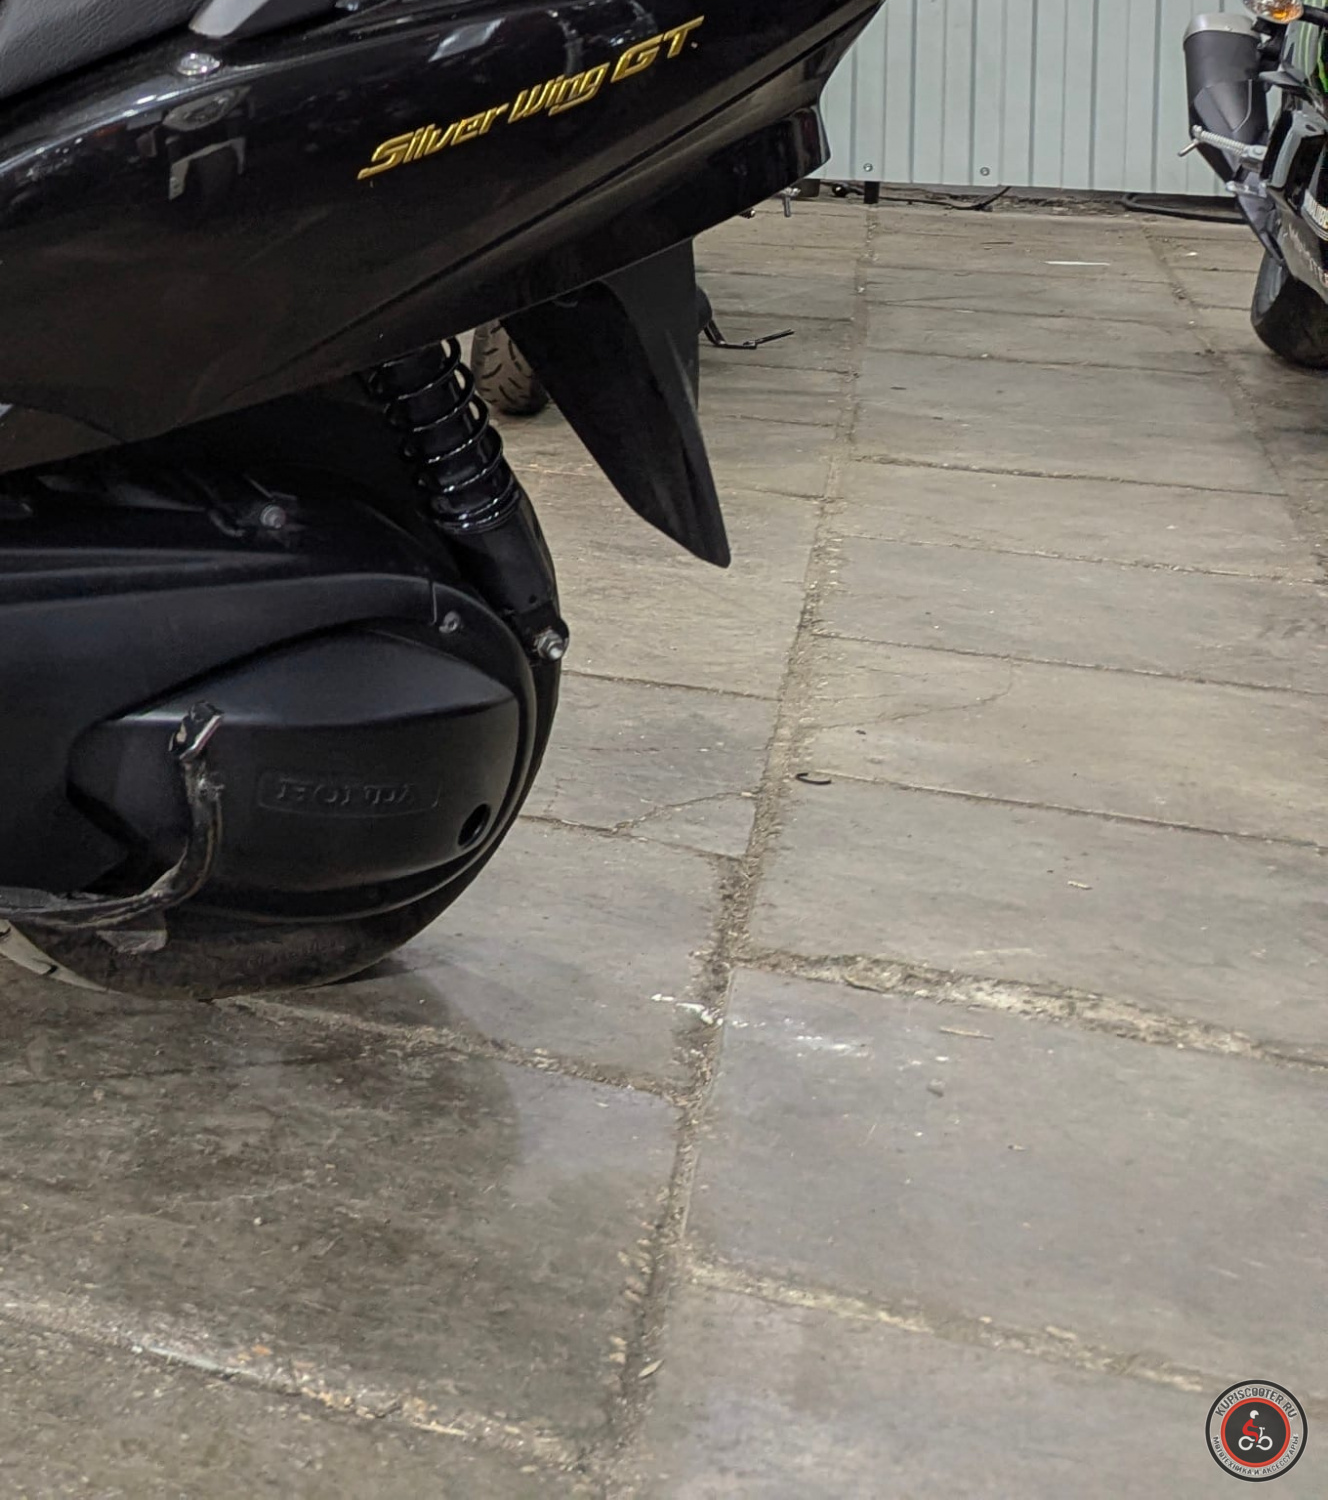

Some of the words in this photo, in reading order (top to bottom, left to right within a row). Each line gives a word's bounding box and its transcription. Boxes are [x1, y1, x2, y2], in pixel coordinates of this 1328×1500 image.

[356, 102, 509, 180] Silver
[507, 61, 611, 117] Wing
[610, 15, 705, 83] GT
